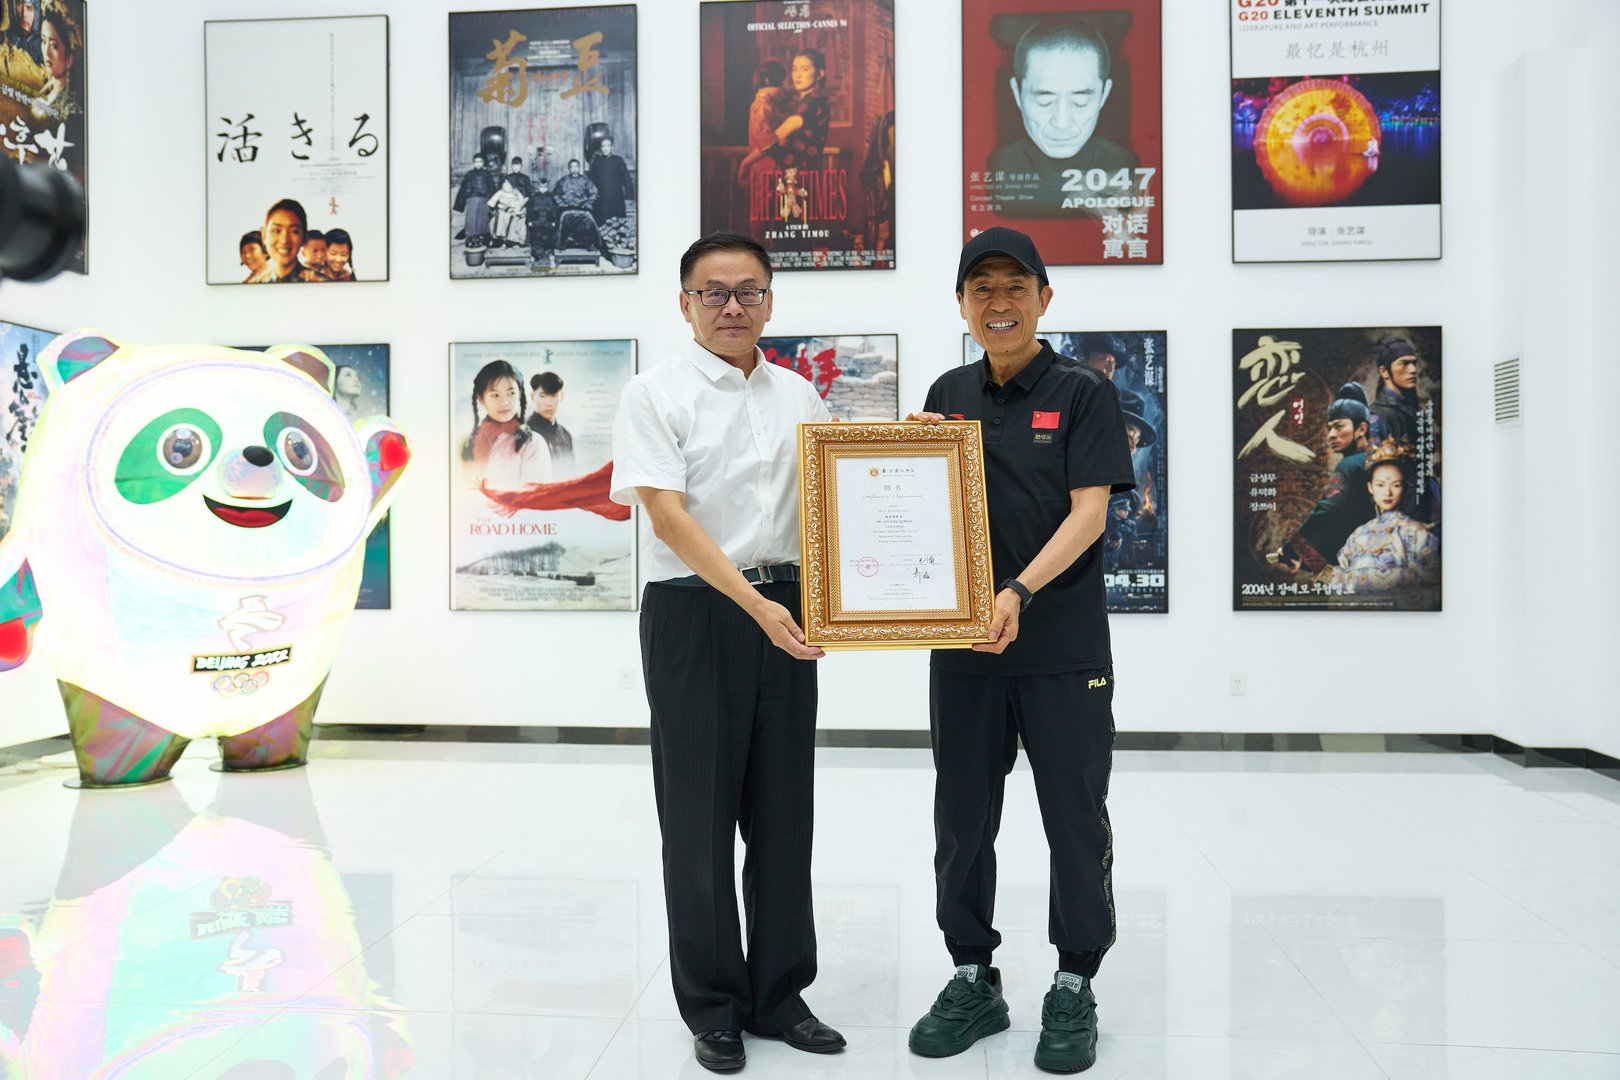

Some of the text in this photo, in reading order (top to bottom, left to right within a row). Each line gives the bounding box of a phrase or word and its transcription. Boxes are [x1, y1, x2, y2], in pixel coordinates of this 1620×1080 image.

[1239, 11, 1268, 21] G20
[1274, 6, 1358, 20] ELEVENTH
[1364, 3, 1429, 16] SUMMIT
[747, 22, 776, 31] OFFICIAL
[1239, 23, 1283, 32] LITERATURE
[1320, 20, 1378, 28] PERFORMANCE
[1286, 39, 1389, 60] 最忆是杭州
[216, 113, 379, 163] 活きる
[970, 171, 1004, 182] 张艺谋
[1061, 167, 1156, 192] 2047
[1061, 196, 1155, 209] APOLOGUE
[1102, 214, 1149, 235] 对话
[765, 230, 830, 239] ZHANG YIMOU
[1103, 238, 1149, 259] 寓言
[470, 523, 557, 535] ROAD HOME
[196, 649, 289, 671] BEIJING 2022
[1088, 677, 1106, 689] FILA
